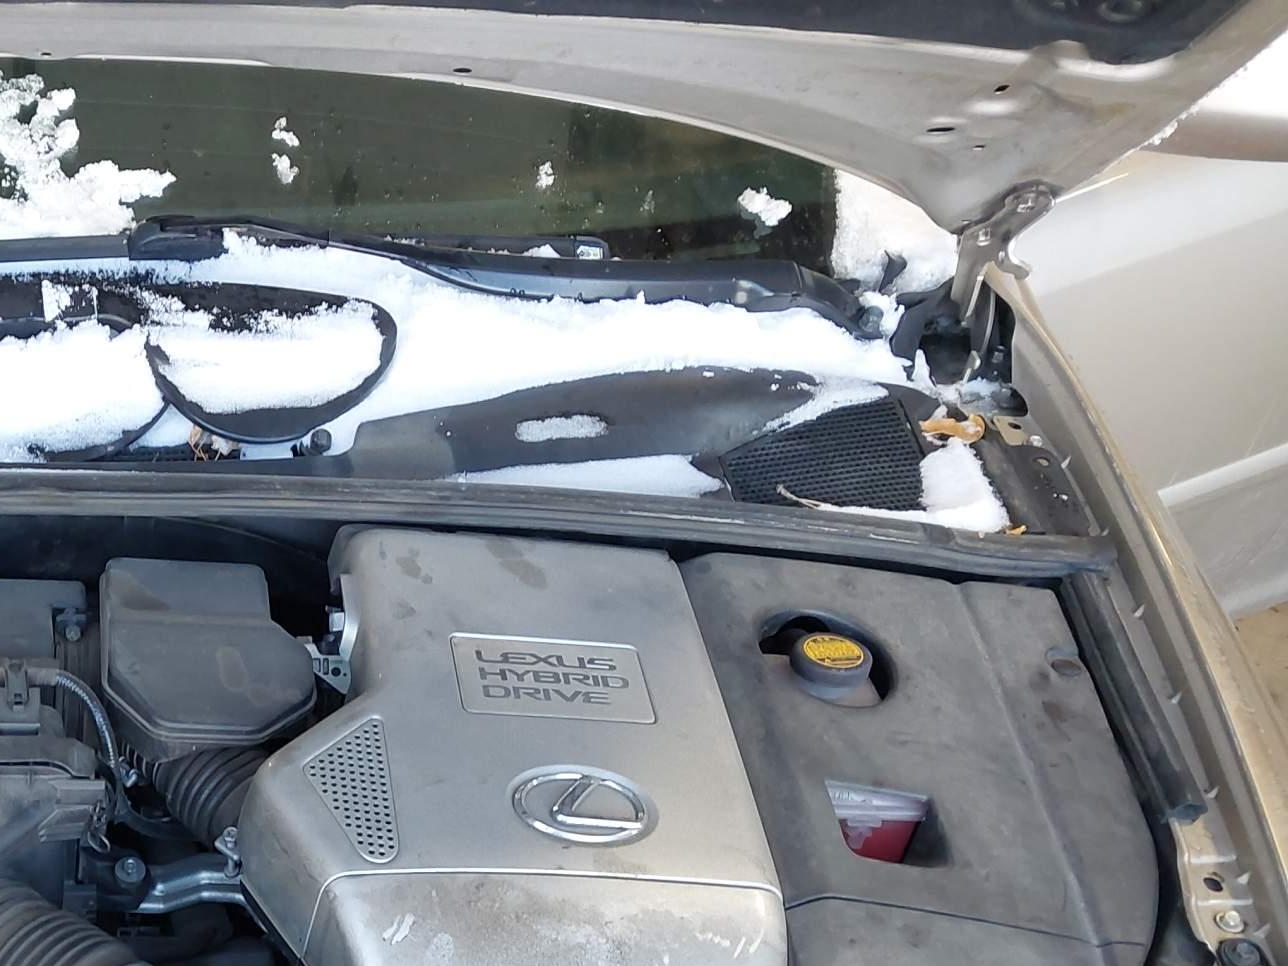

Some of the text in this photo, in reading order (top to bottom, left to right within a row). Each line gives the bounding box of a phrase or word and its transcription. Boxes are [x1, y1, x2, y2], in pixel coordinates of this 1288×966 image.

[475, 650, 617, 671] LEXUS
[479, 667, 630, 689] HYBRID
[483, 684, 613, 705] DRIVE
